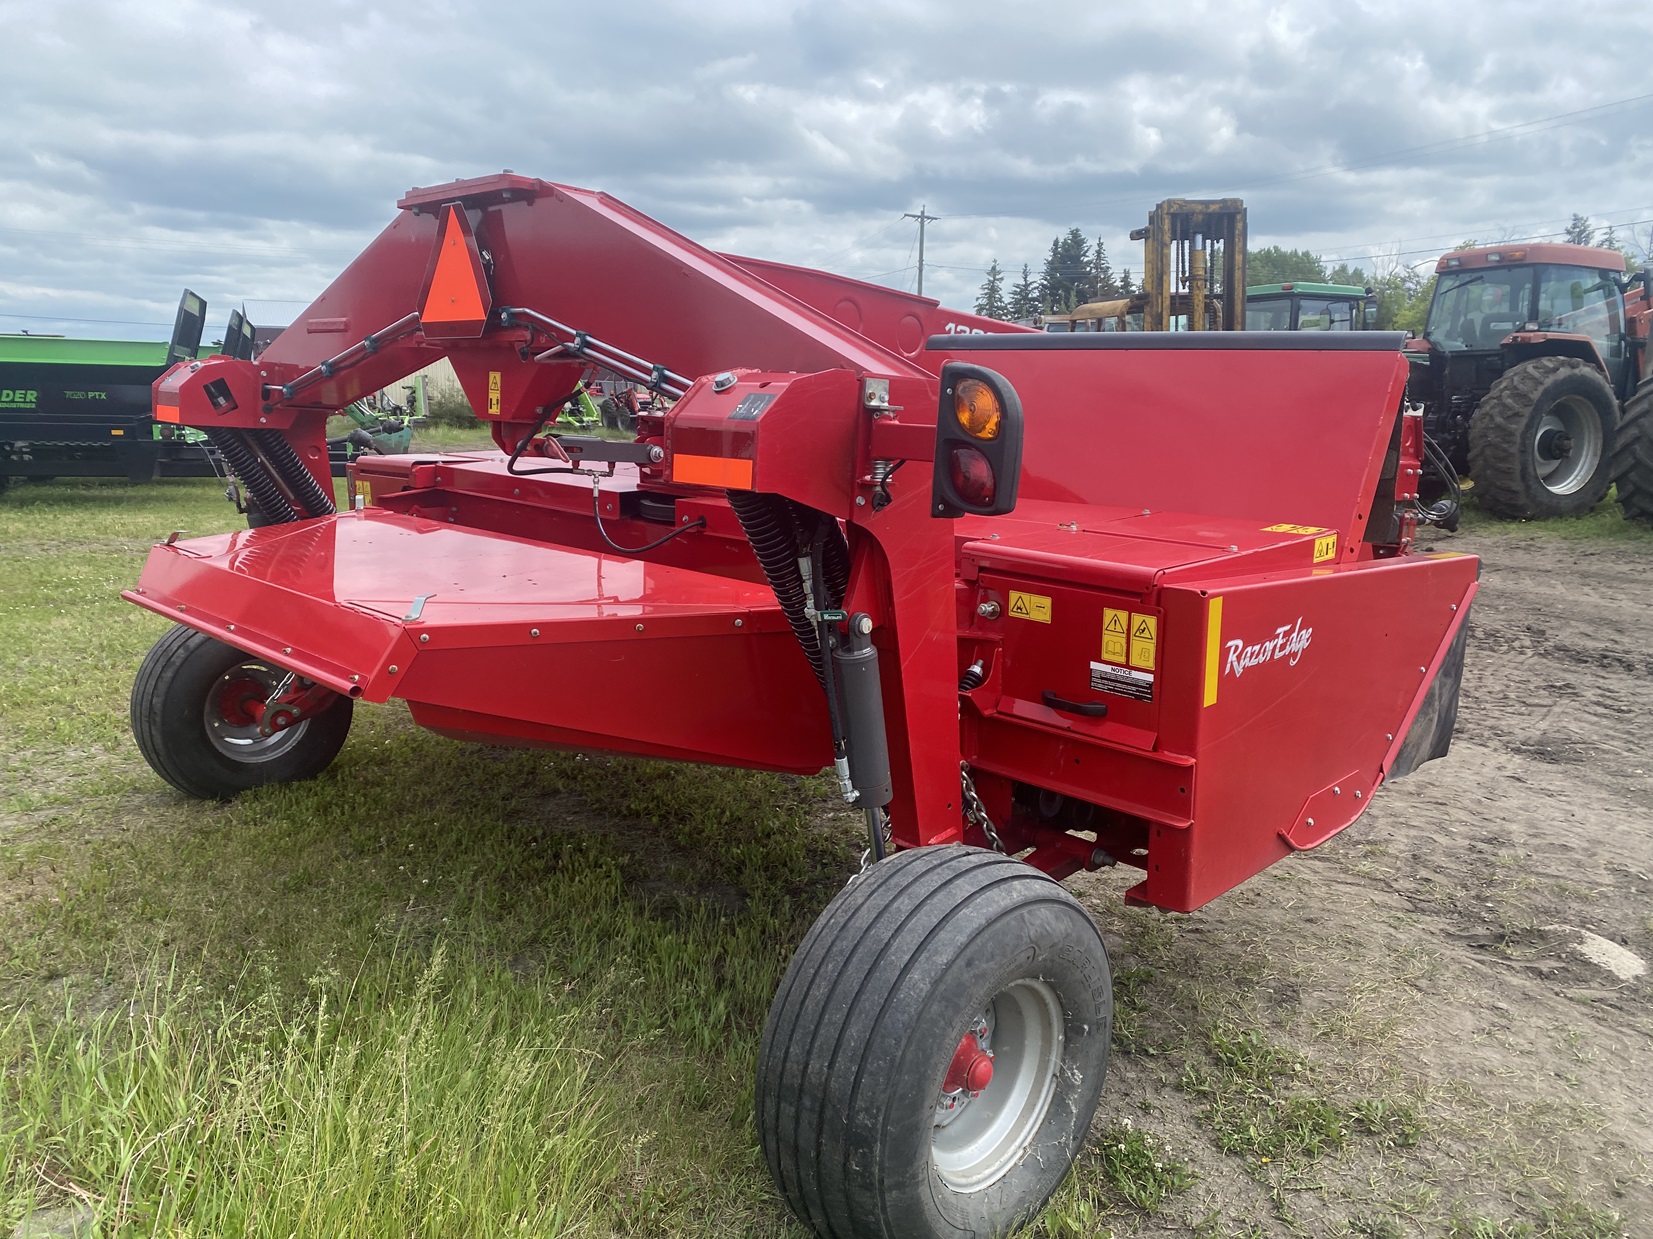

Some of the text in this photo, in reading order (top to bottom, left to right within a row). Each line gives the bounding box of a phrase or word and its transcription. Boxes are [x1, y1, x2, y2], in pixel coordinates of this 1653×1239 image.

[88, 391, 106, 399] PTX
[1224, 615, 1313, 678] RazorEdge
[1110, 667, 1133, 676] NOTICE
